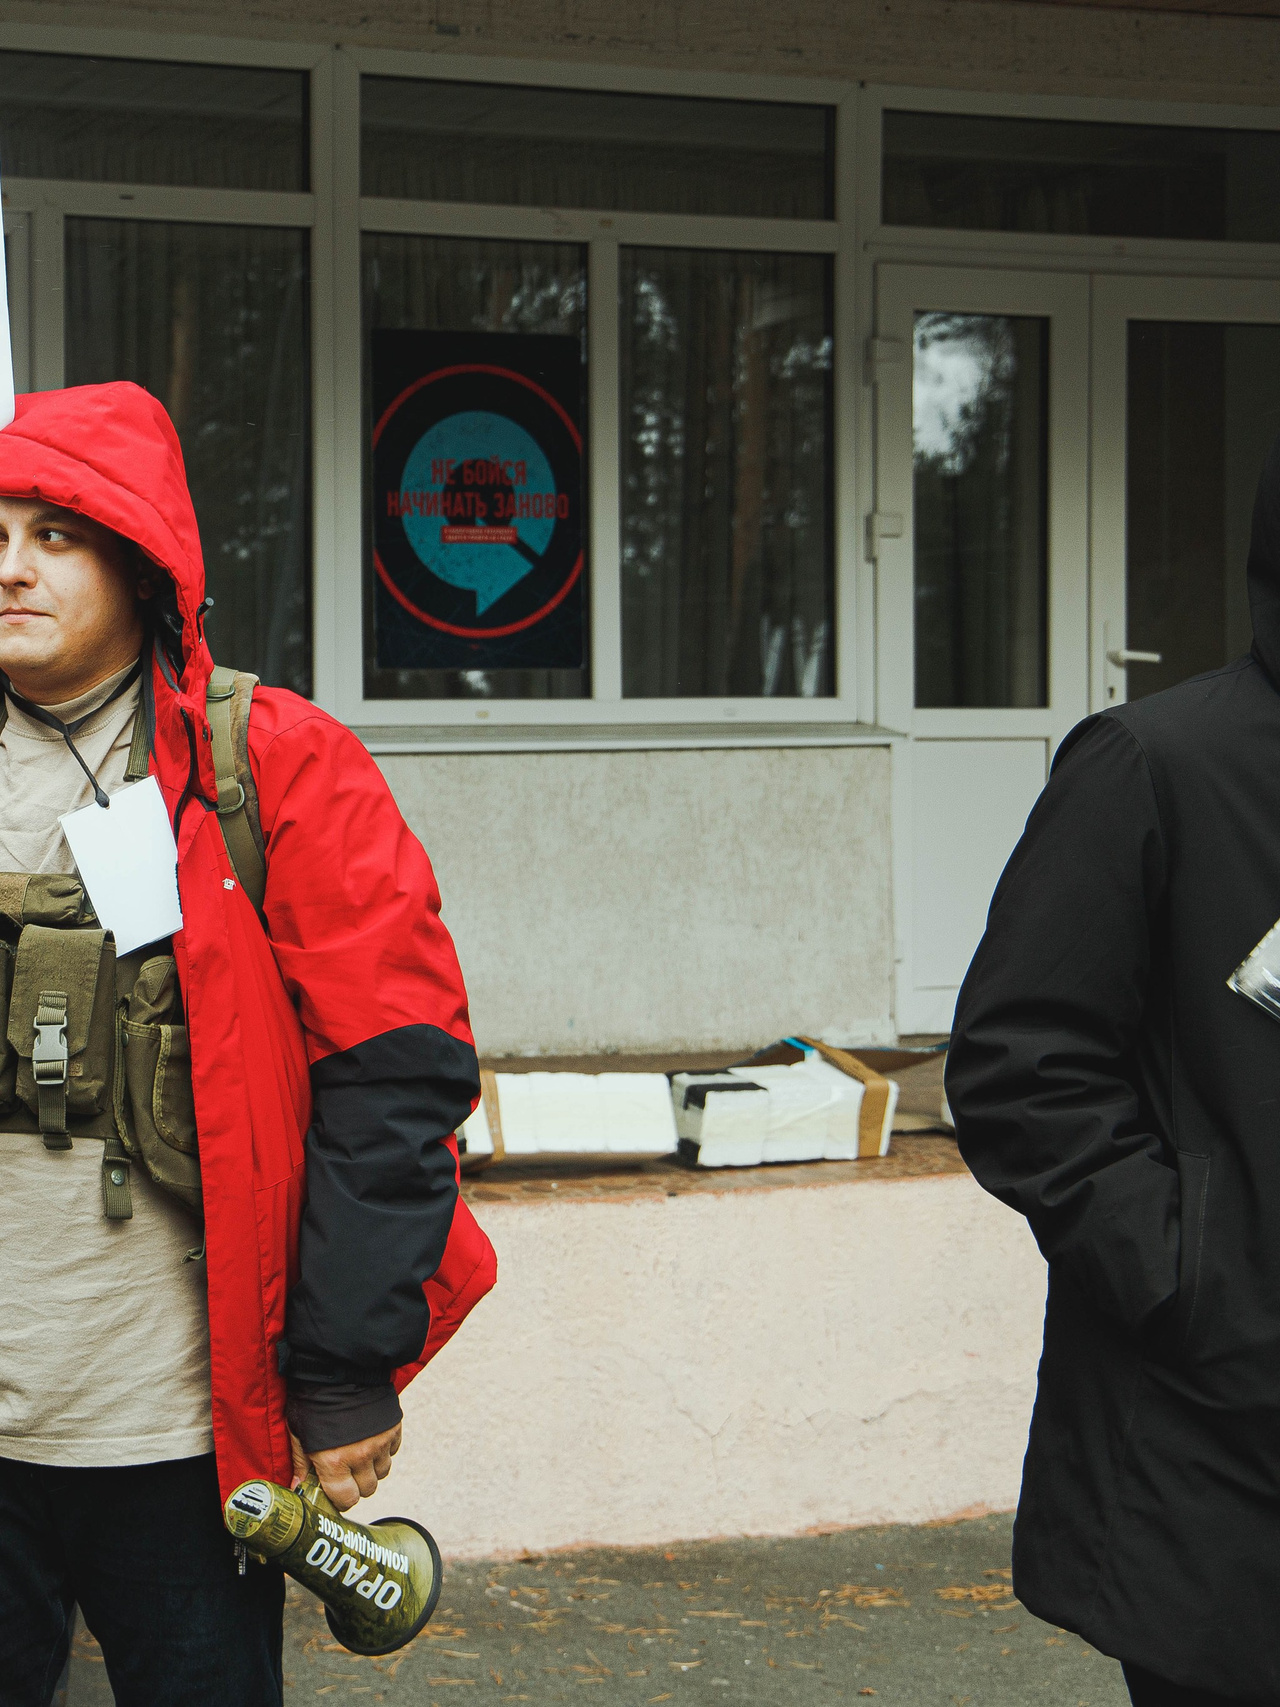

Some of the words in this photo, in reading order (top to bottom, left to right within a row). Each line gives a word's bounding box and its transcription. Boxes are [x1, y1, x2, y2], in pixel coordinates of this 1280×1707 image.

[431, 458, 456, 485] НЕ
[463, 454, 527, 486] БОЙСЯ
[386, 491, 487, 518] НАЧИНАТЬ
[493, 493, 569, 519] ЗАНОВО
[317, 1513, 409, 1574] КОМАНДИРСКОЕ
[305, 1537, 402, 1610] ОРАЛО
